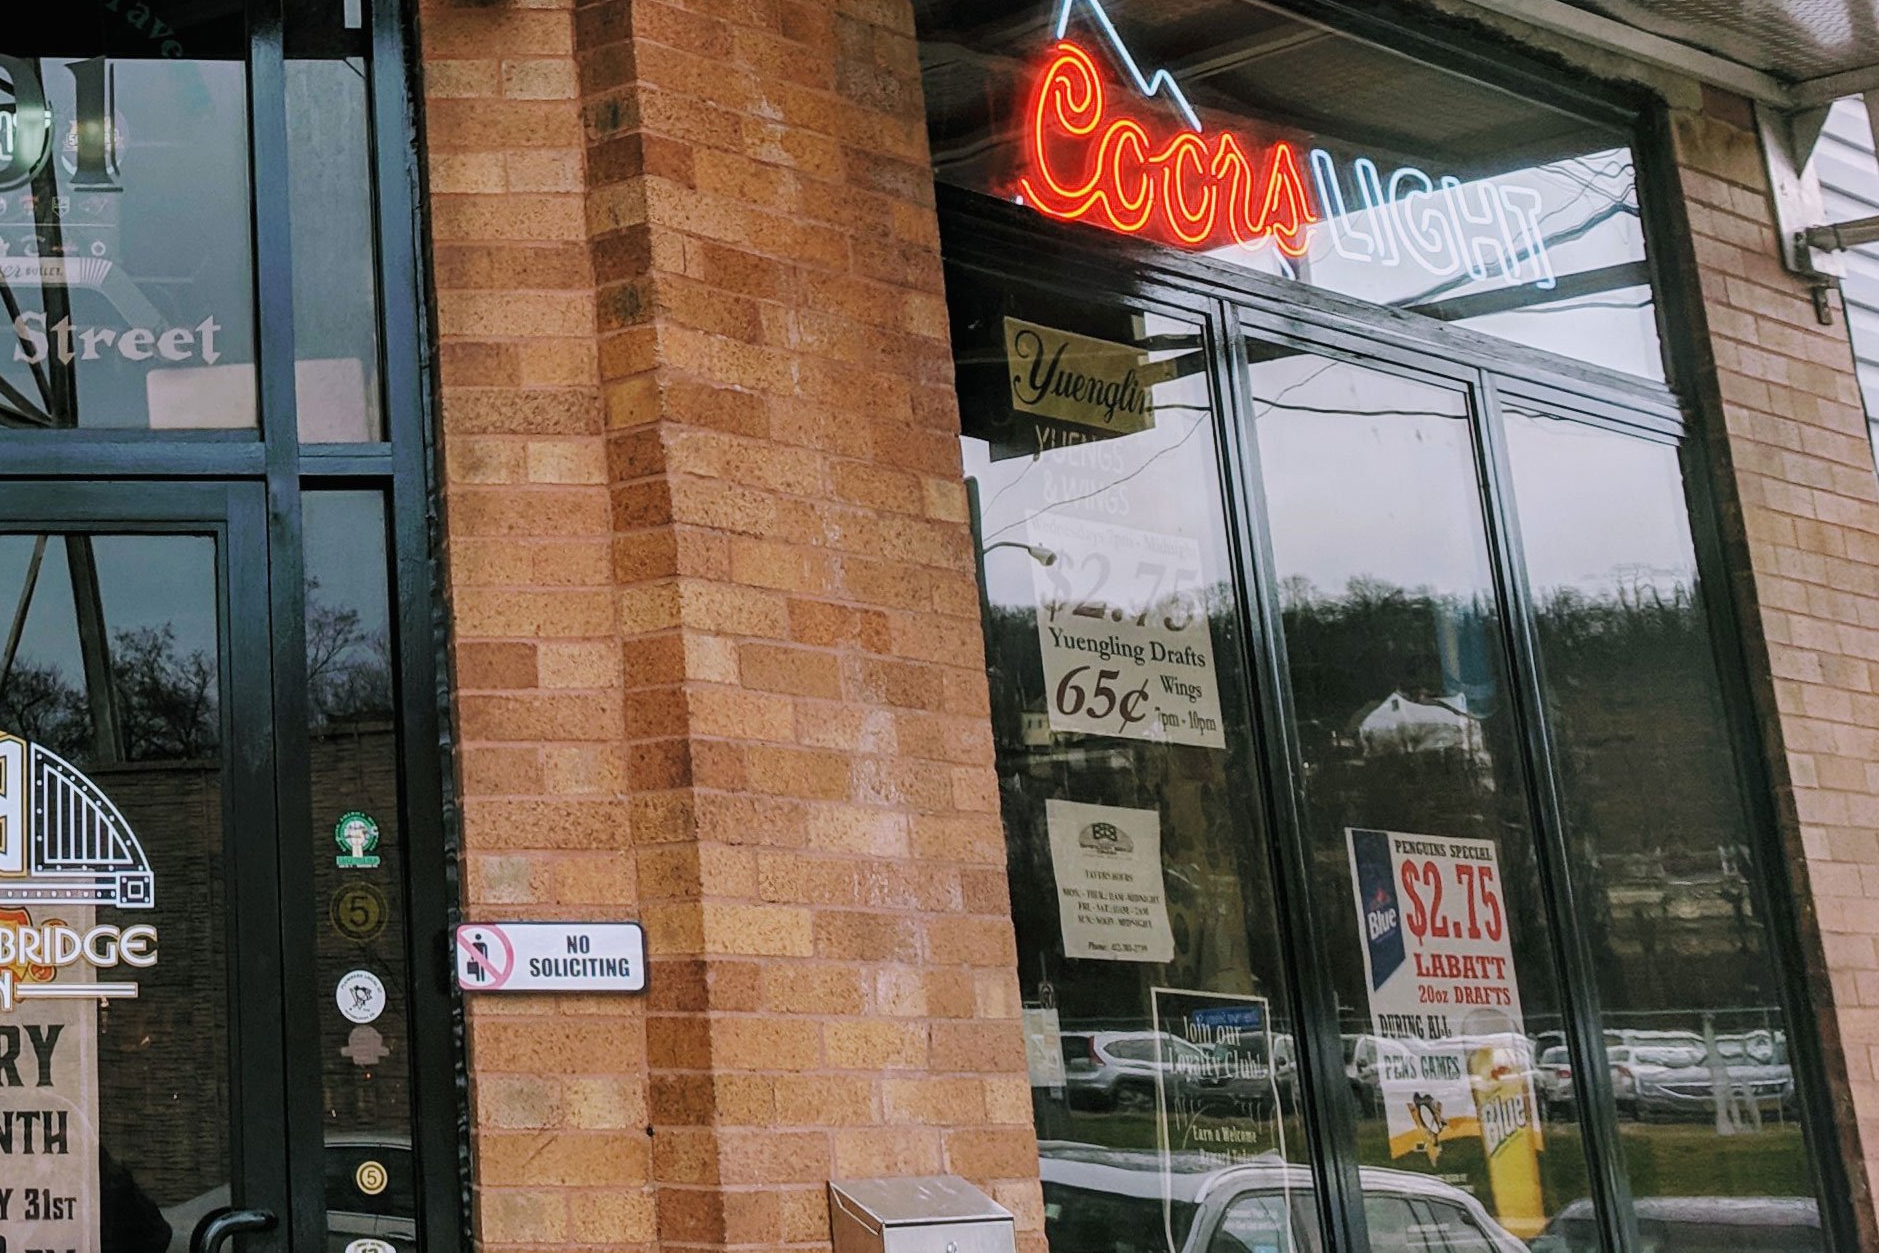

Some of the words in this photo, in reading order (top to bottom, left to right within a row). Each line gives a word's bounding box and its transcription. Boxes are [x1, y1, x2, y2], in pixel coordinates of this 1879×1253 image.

[1020, 43, 1318, 259] Coors
[1308, 149, 1558, 289] LIGHT
[12, 309, 223, 367] Street
[1013, 329, 1156, 424] Yuenglin
[1034, 424, 1126, 476] YUENGS
[1065, 476, 1132, 516] WINGS
[1043, 549, 1198, 632] $2.75
[1048, 626, 1146, 666] Yuengling
[1149, 641, 1207, 668] Drafts
[1055, 665, 1150, 734] 65¢
[1159, 674, 1203, 703] Wings
[1188, 710, 1218, 735] 10pm
[1394, 839, 1447, 858] PENGUINS
[1449, 844, 1493, 862] SPECIAL
[348, 895, 370, 927] 5
[1401, 858, 1503, 947] $2.75
[1367, 906, 1398, 941] Blue
[566, 934, 590, 955] NO
[529, 958, 631, 978] SOLICITING
[1413, 952, 1506, 980] LABATT
[1418, 984, 1449, 1004] 20oz
[1454, 985, 1511, 1006] DRAFTS
[1183, 1015, 1212, 1046] Join
[1216, 1025, 1242, 1047] our
[1377, 1013, 1425, 1039] DURING
[1428, 1014, 1453, 1039] ALL
[1169, 1046, 1221, 1085] Loyalty
[1383, 1054, 1418, 1081] PENS
[1419, 1055, 1461, 1081] GAMES
[1192, 1124, 1214, 1142] Earn
[1215, 1129, 1221, 1142] a
[1482, 1095, 1526, 1154] Blue
[366, 1169, 378, 1187] 5
